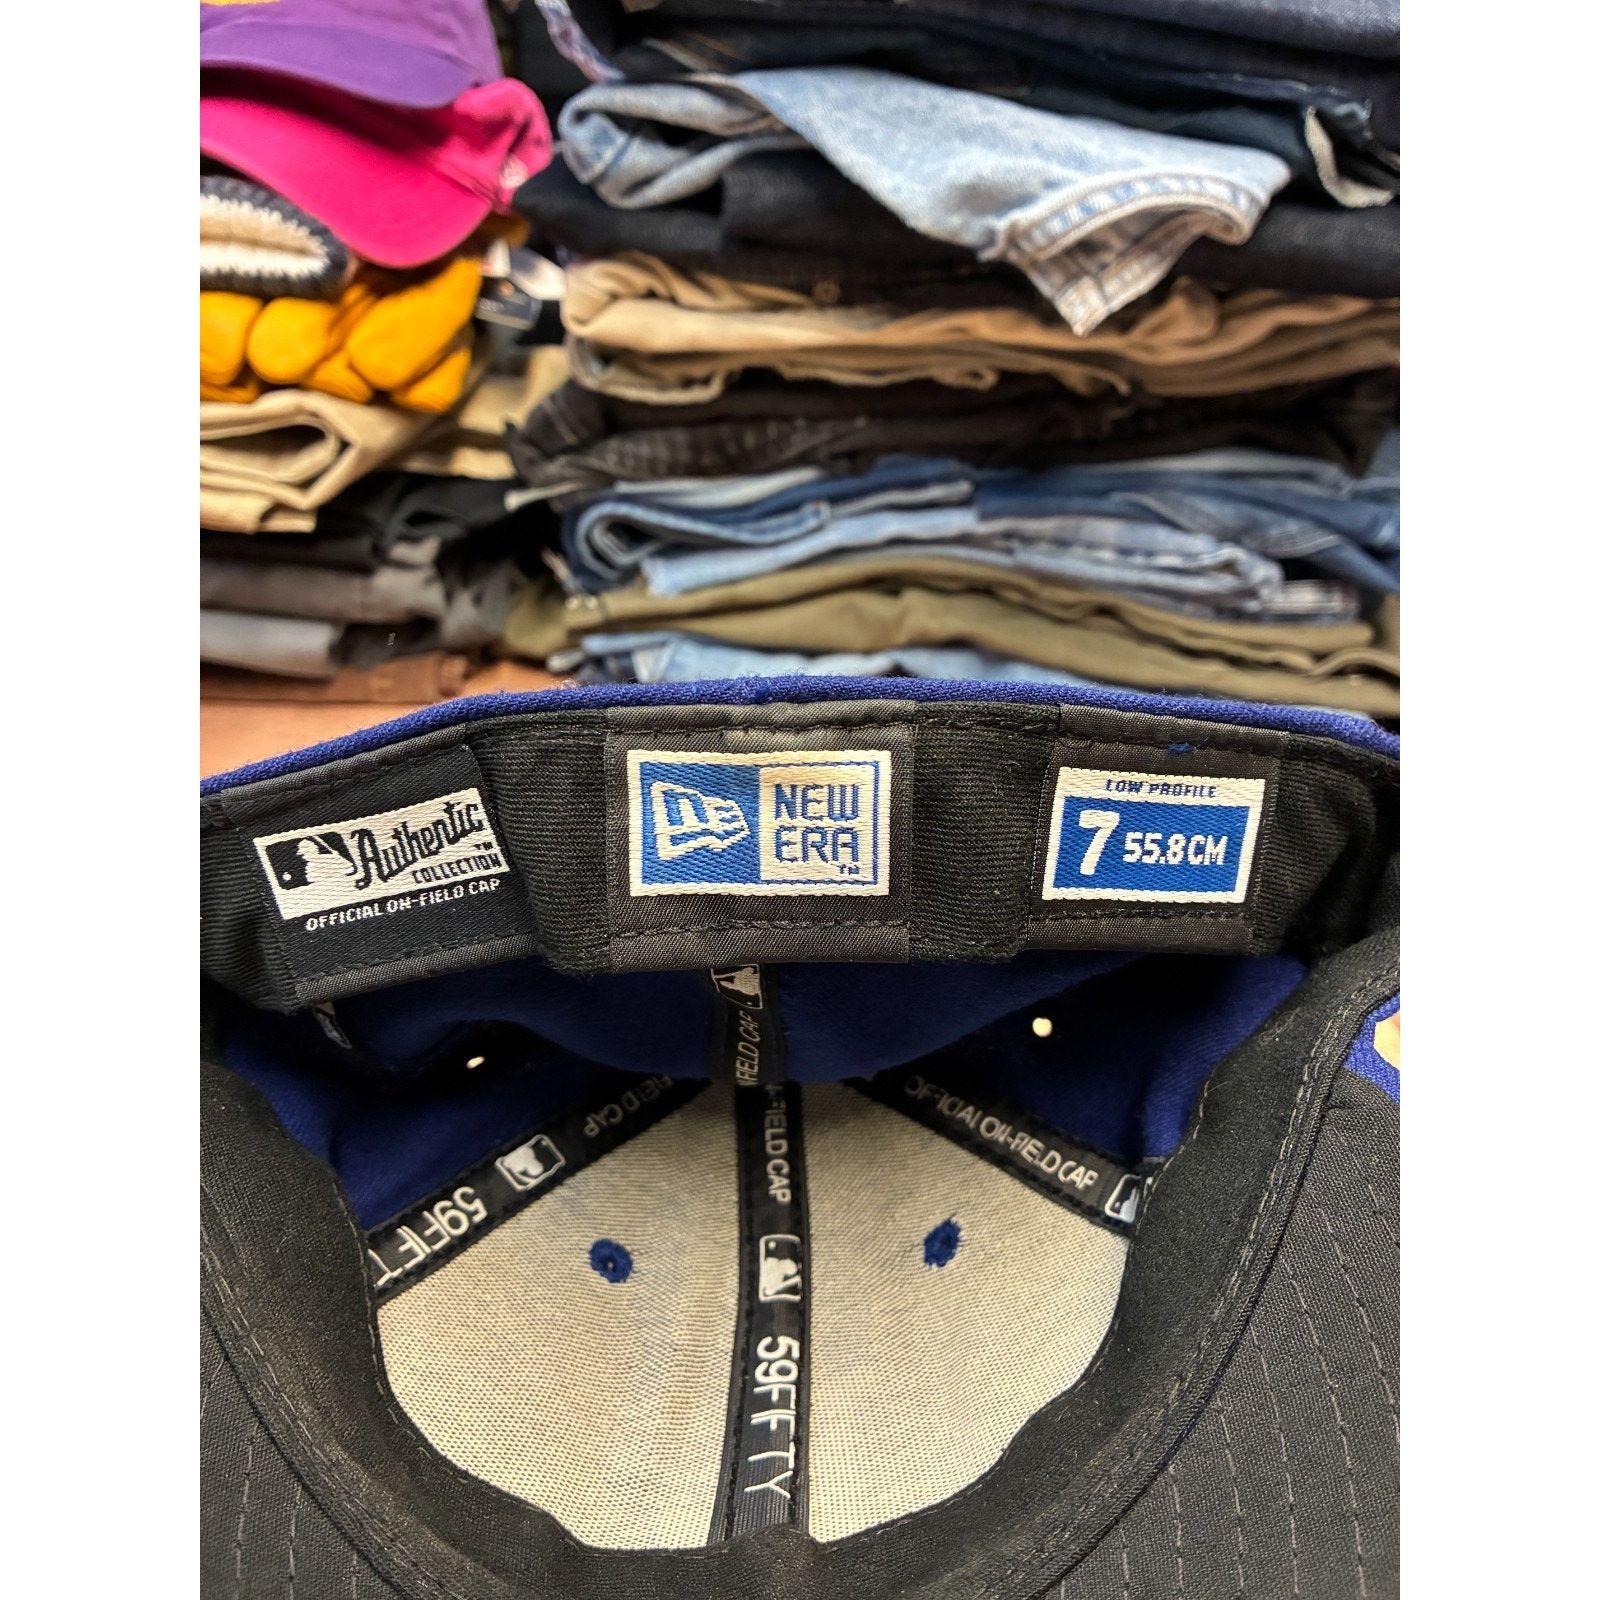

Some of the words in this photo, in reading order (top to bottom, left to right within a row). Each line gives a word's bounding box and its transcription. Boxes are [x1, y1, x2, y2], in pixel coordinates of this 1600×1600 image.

[774, 783, 859, 821] NEW
[1105, 778, 1143, 795] LOW
[1148, 782, 1218, 798] PROFILE
[350, 801, 486, 891] Authentic
[774, 825, 859, 863] ERA
[1078, 809, 1120, 876] 7
[411, 853, 502, 884] COLLECTION
[305, 903, 384, 931] OFFICIAL
[386, 884, 465, 914] ON-FIELD
[468, 878, 502, 896] CAP
[738, 1008, 761, 1042] CAP
[766, 1158, 792, 1205] CAP
[1057, 1160, 1099, 1191] CAP
[366, 1185, 488, 1290] 59FIFT
[743, 1335, 801, 1499] 59FIFTY
